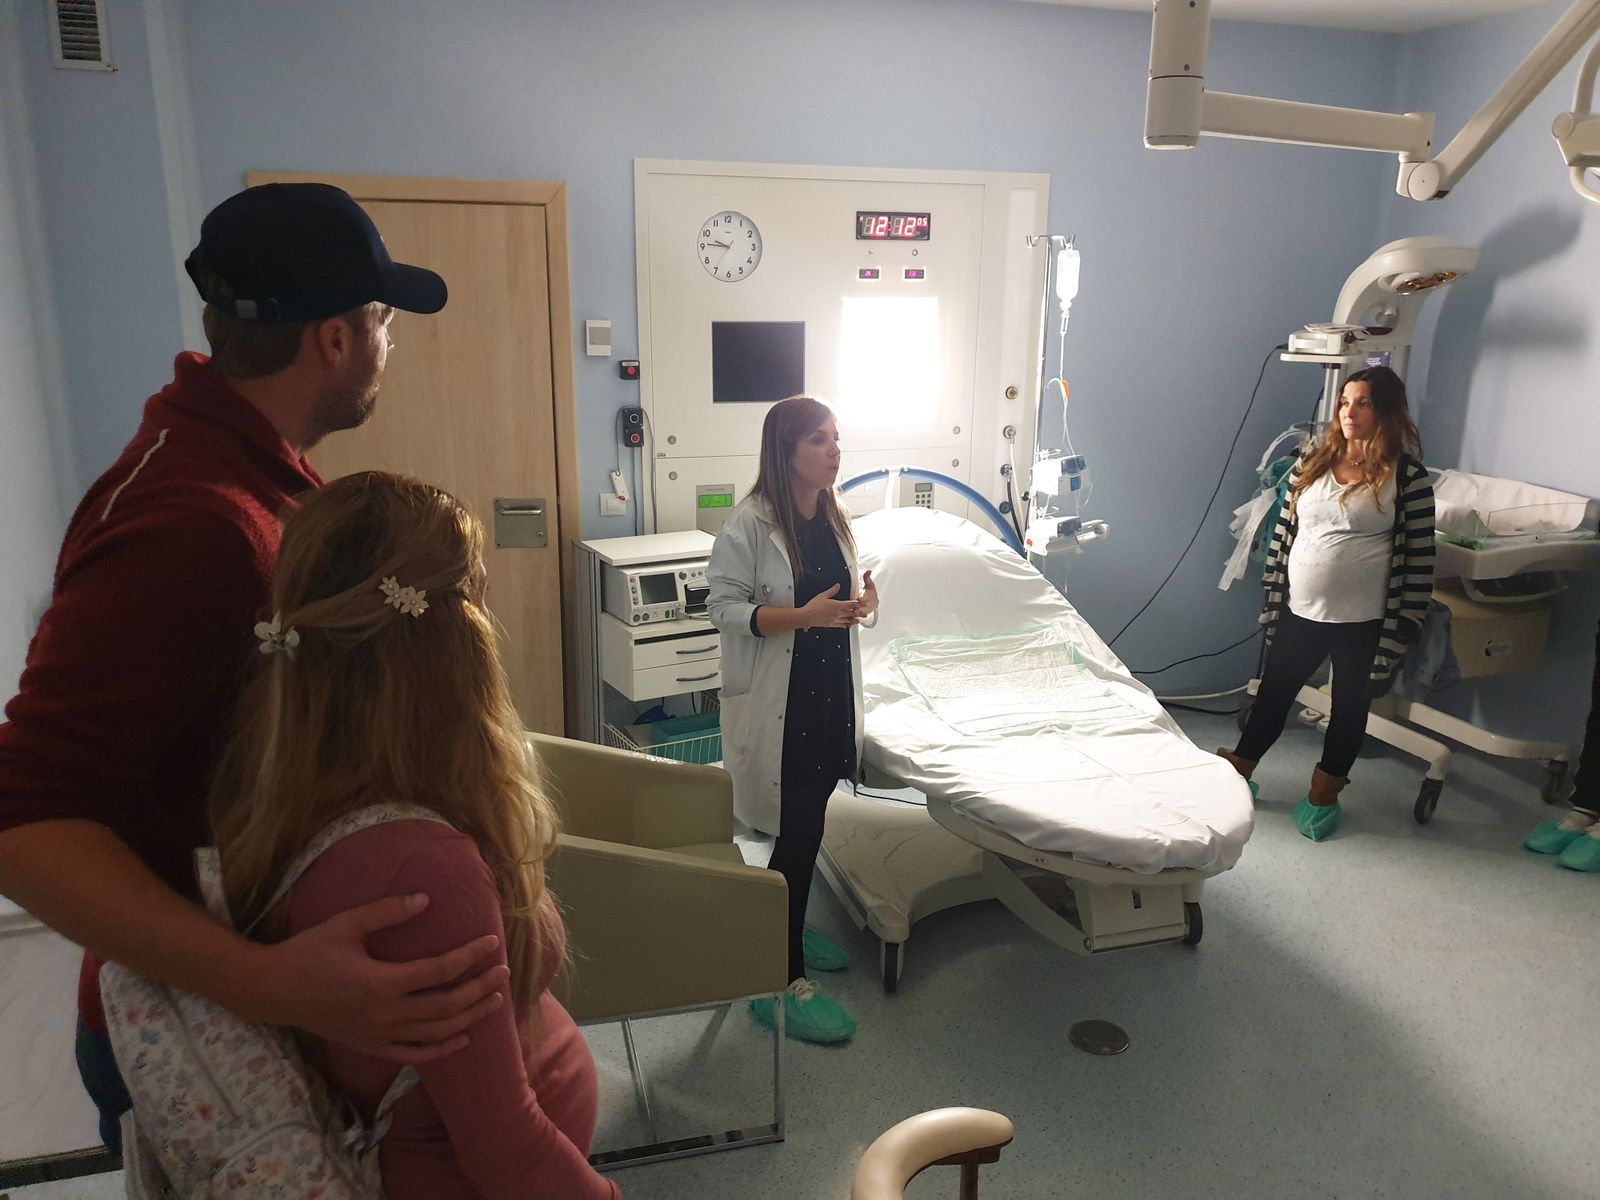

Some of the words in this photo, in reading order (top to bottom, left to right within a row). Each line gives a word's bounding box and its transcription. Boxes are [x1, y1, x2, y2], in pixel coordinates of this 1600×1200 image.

[713, 219, 719, 227] 11
[724, 215, 732, 223] 12
[917, 217, 928, 226] 05
[702, 229, 711, 237] 10
[747, 230, 753, 238] 2
[699, 243, 706, 251] 9
[751, 243, 756, 251] 3
[704, 256, 710, 264] 8
[746, 256, 753, 264] 4
[713, 266, 719, 275] 7
[726, 270, 731, 278] 6
[738, 266, 744, 274] 5
